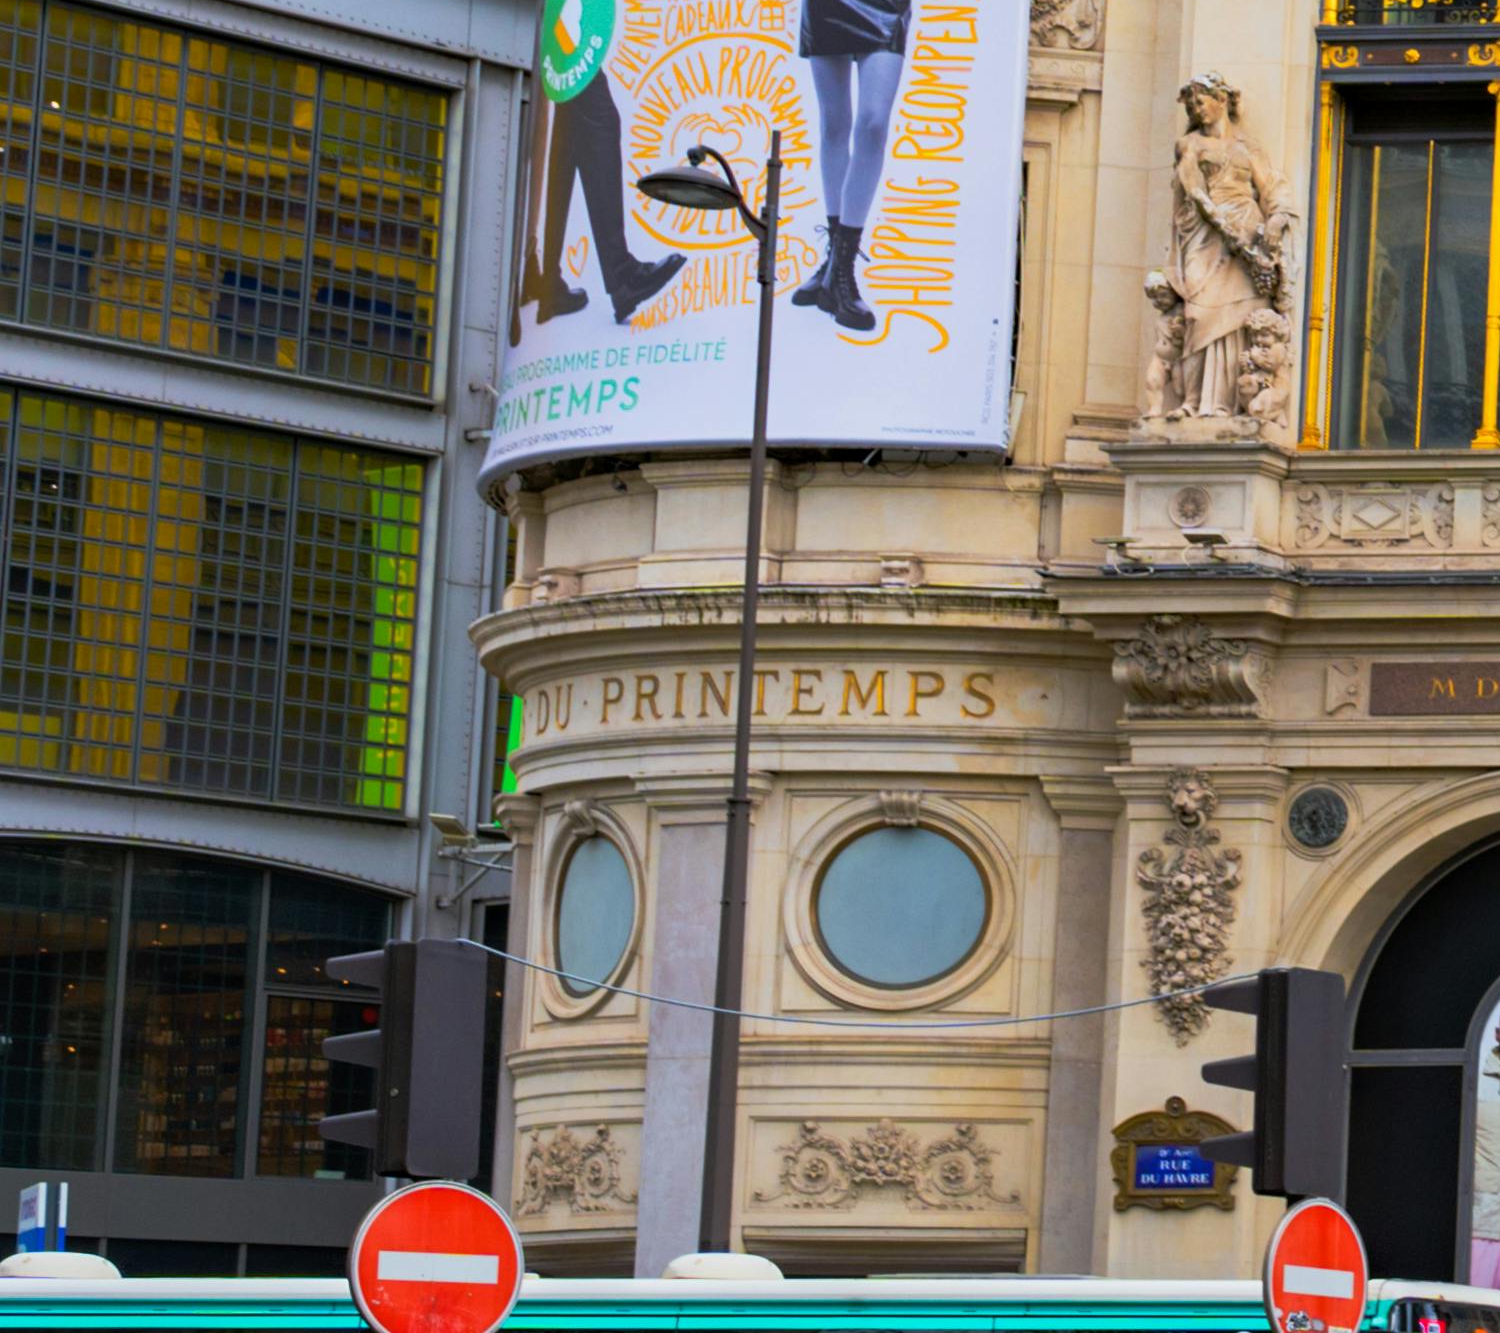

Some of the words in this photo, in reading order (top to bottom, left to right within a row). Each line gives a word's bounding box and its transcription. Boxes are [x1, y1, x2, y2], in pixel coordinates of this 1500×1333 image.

[628, 51, 714, 159] NOUVEAU
[836, 176, 962, 353] SHOPPING
[605, 346, 631, 368] DE
[600, 667, 998, 726] PRINTEMPS
[1427, 677, 1457, 699] M
[1159, 1159, 1192, 1171] RUE
[1140, 1173, 1159, 1184] DU
